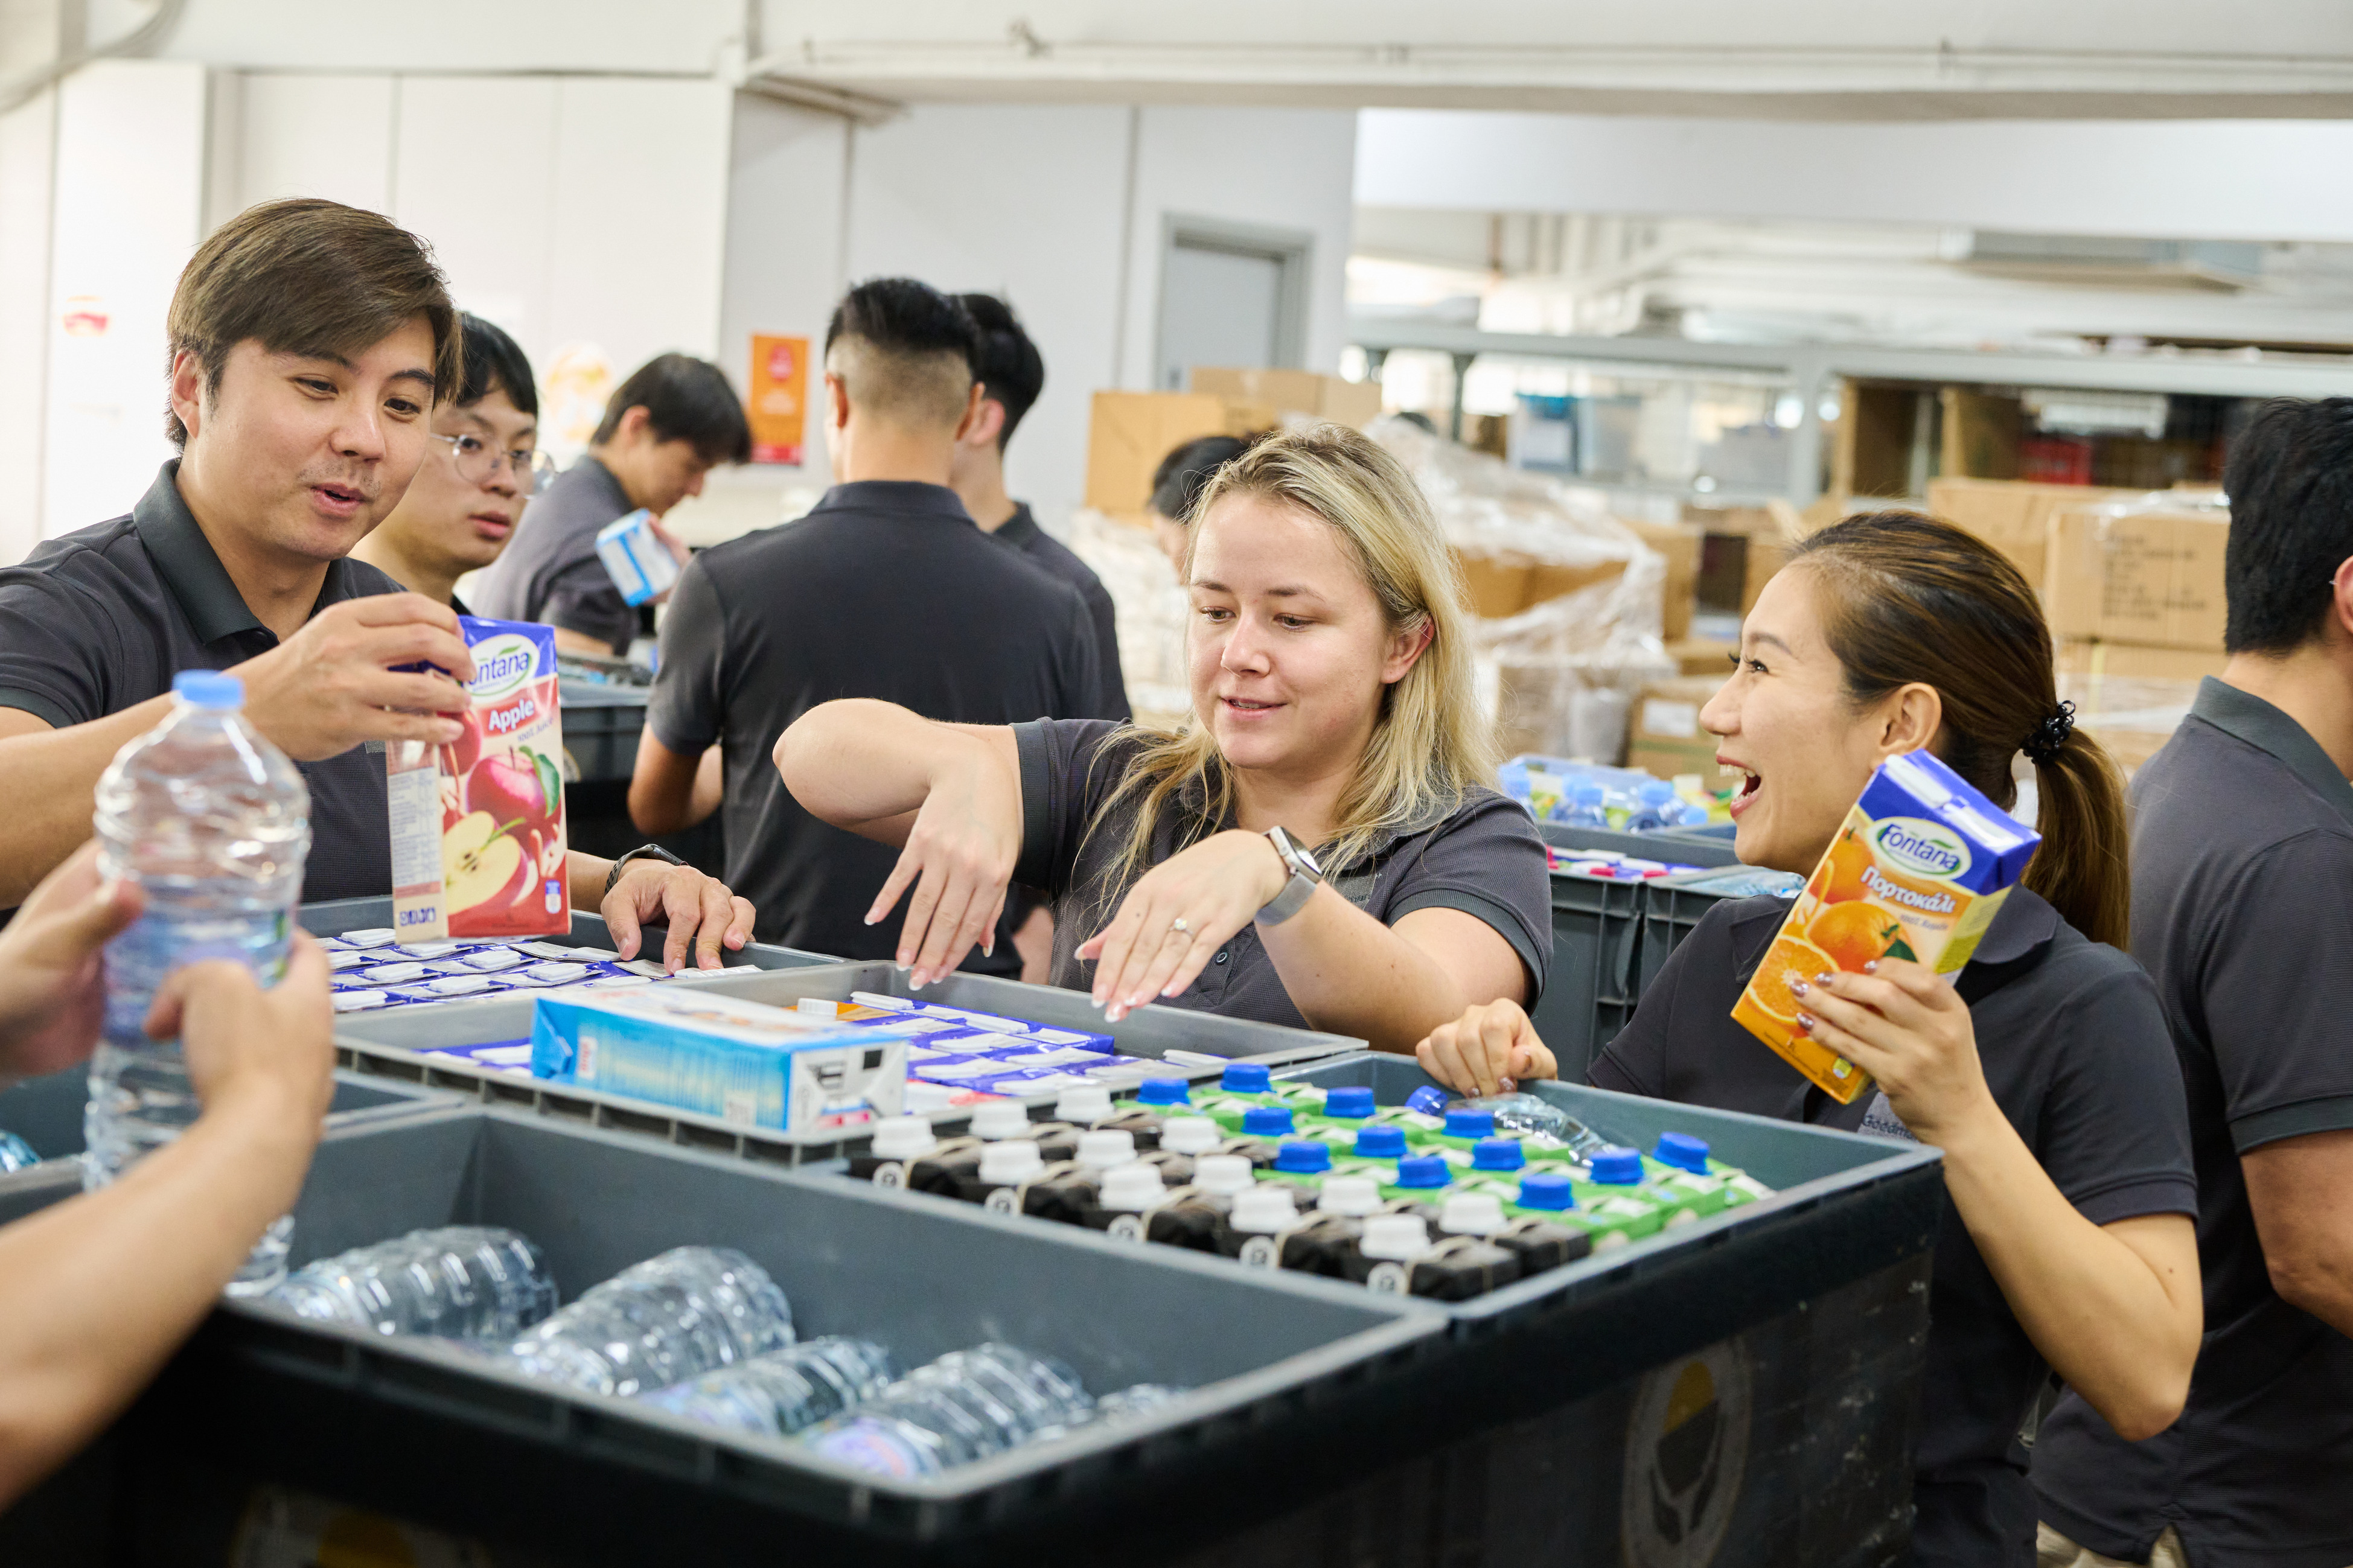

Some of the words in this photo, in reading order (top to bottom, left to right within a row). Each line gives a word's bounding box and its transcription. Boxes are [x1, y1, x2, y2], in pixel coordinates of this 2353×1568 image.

[468, 652, 531, 686] ntana
[488, 698, 534, 734] Apple
[1878, 823, 1960, 871] Fontana
[1860, 865, 1957, 913] Πορτοκάλι
